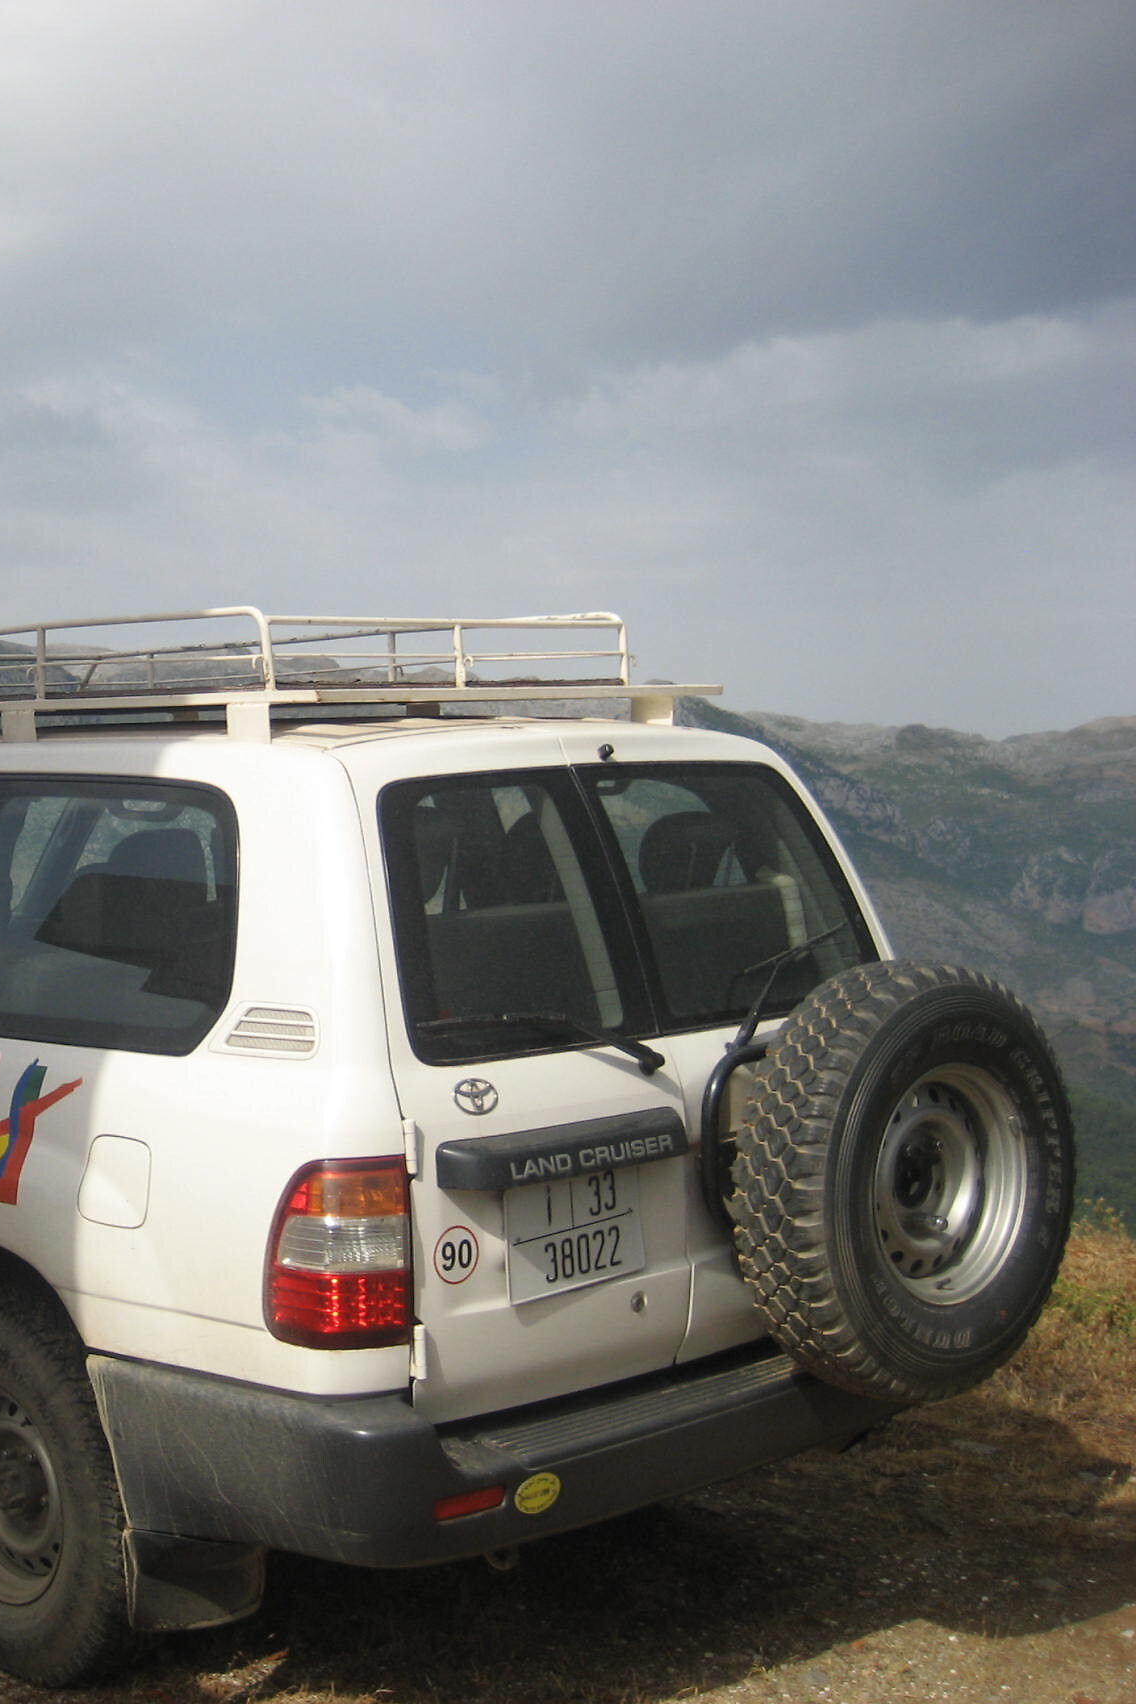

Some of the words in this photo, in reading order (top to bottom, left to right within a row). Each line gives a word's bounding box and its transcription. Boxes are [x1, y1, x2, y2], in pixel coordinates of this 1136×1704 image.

[510, 1153, 572, 1180] LAND
[579, 1134, 674, 1168] CRUISER
[588, 1169, 617, 1217] 33
[441, 1239, 472, 1271] 90
[544, 1225, 623, 1284] 38022
